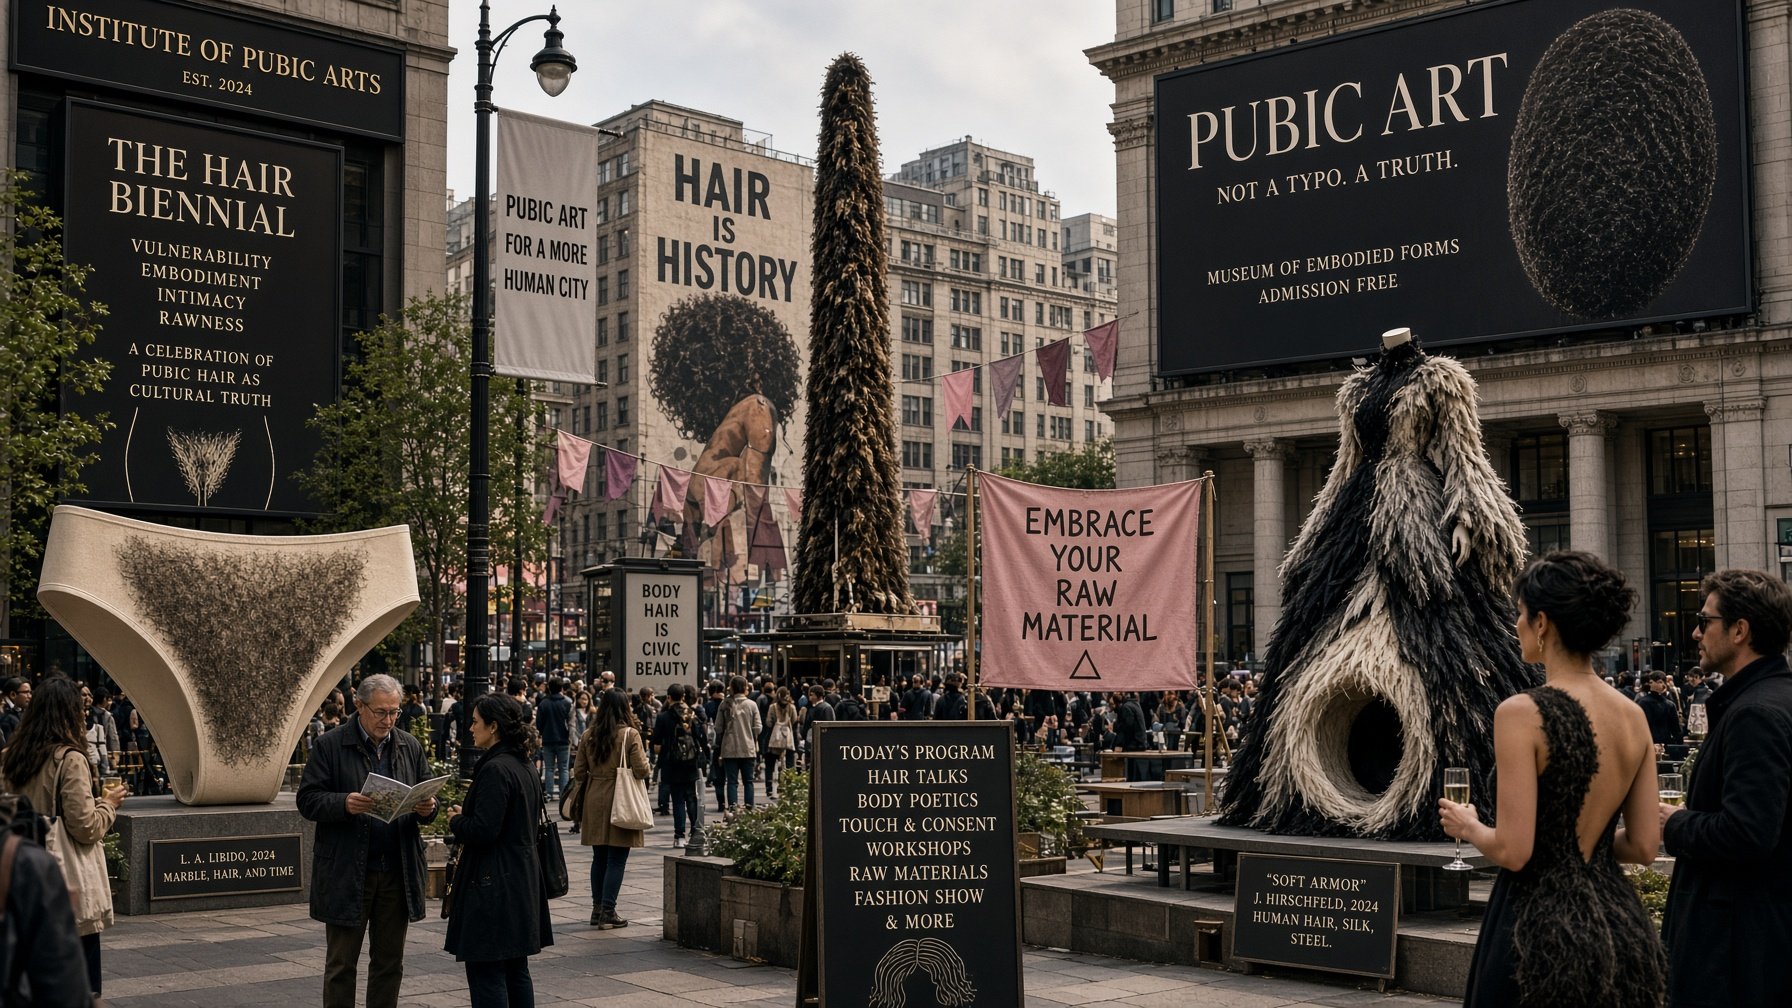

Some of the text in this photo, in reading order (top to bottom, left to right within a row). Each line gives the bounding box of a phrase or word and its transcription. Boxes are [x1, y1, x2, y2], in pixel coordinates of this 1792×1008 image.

[47, 6, 380, 94] INSTITUTE OF PUBIC ARTS
[183, 71, 252, 95] EST. 2024
[1187, 53, 1507, 170] PUBIC ART
[108, 138, 294, 197] THE HAIR
[1218, 150, 1457, 204] NOT A TYPO. A TRUTH.
[675, 153, 771, 220] HAIR
[109, 180, 294, 237] BIENNIAL
[507, 195, 587, 229] PUBIC ART
[714, 216, 735, 243] IS
[132, 239, 271, 270] VULNERABILITY
[506, 233, 587, 265] FOR A MORE
[658, 236, 797, 302] HISTORY
[1208, 239, 1459, 285] MUSEUM OF EMBODIED FORMS
[142, 263, 261, 290] EMBODIMENT
[505, 269, 588, 300] HUMAN CITY
[158, 288, 245, 309] INTIMACY
[1259, 274, 1397, 303] ADMISSION FREE
[160, 311, 243, 332] RAWNESS
[129, 343, 273, 366] A CELEBRATION OF
[142, 364, 259, 385] PUBIC HAIR AS
[130, 384, 270, 407] CULTURAL TRUTH
[1026, 507, 1154, 537] EMBRACE
[1050, 544, 1122, 572] YOUR
[643, 584, 680, 598] BODY
[1057, 579, 1117, 606] RAW
[645, 604, 678, 617] HAIR
[656, 623, 668, 636] IS
[1023, 612, 1157, 641] MATERIAL
[643, 642, 680, 656] CIVIC
[636, 662, 688, 675] BEAUTY
[916, 745, 994, 759] PROGRAM
[868, 769, 967, 784] HAIR TALKS
[858, 793, 978, 808] BODY POETICS
[839, 817, 996, 832] TOUCH & CONSENT
[181, 850, 275, 864] L. A. LIBIDO, 2024
[867, 841, 971, 856] WORKSHOPS
[164, 866, 294, 882] MARBLE, HAIR, AND TIME
[850, 865, 987, 881] RAW MATERIALS
[855, 889, 984, 905] FASHION SHOW
[1254, 893, 1378, 912] J. HIRSCHFELD, 2024
[886, 913, 954, 929] & MORE
[1254, 911, 1373, 934] HUMAN HAIR, SILK,
[1291, 933, 1331, 947] STEEL.
